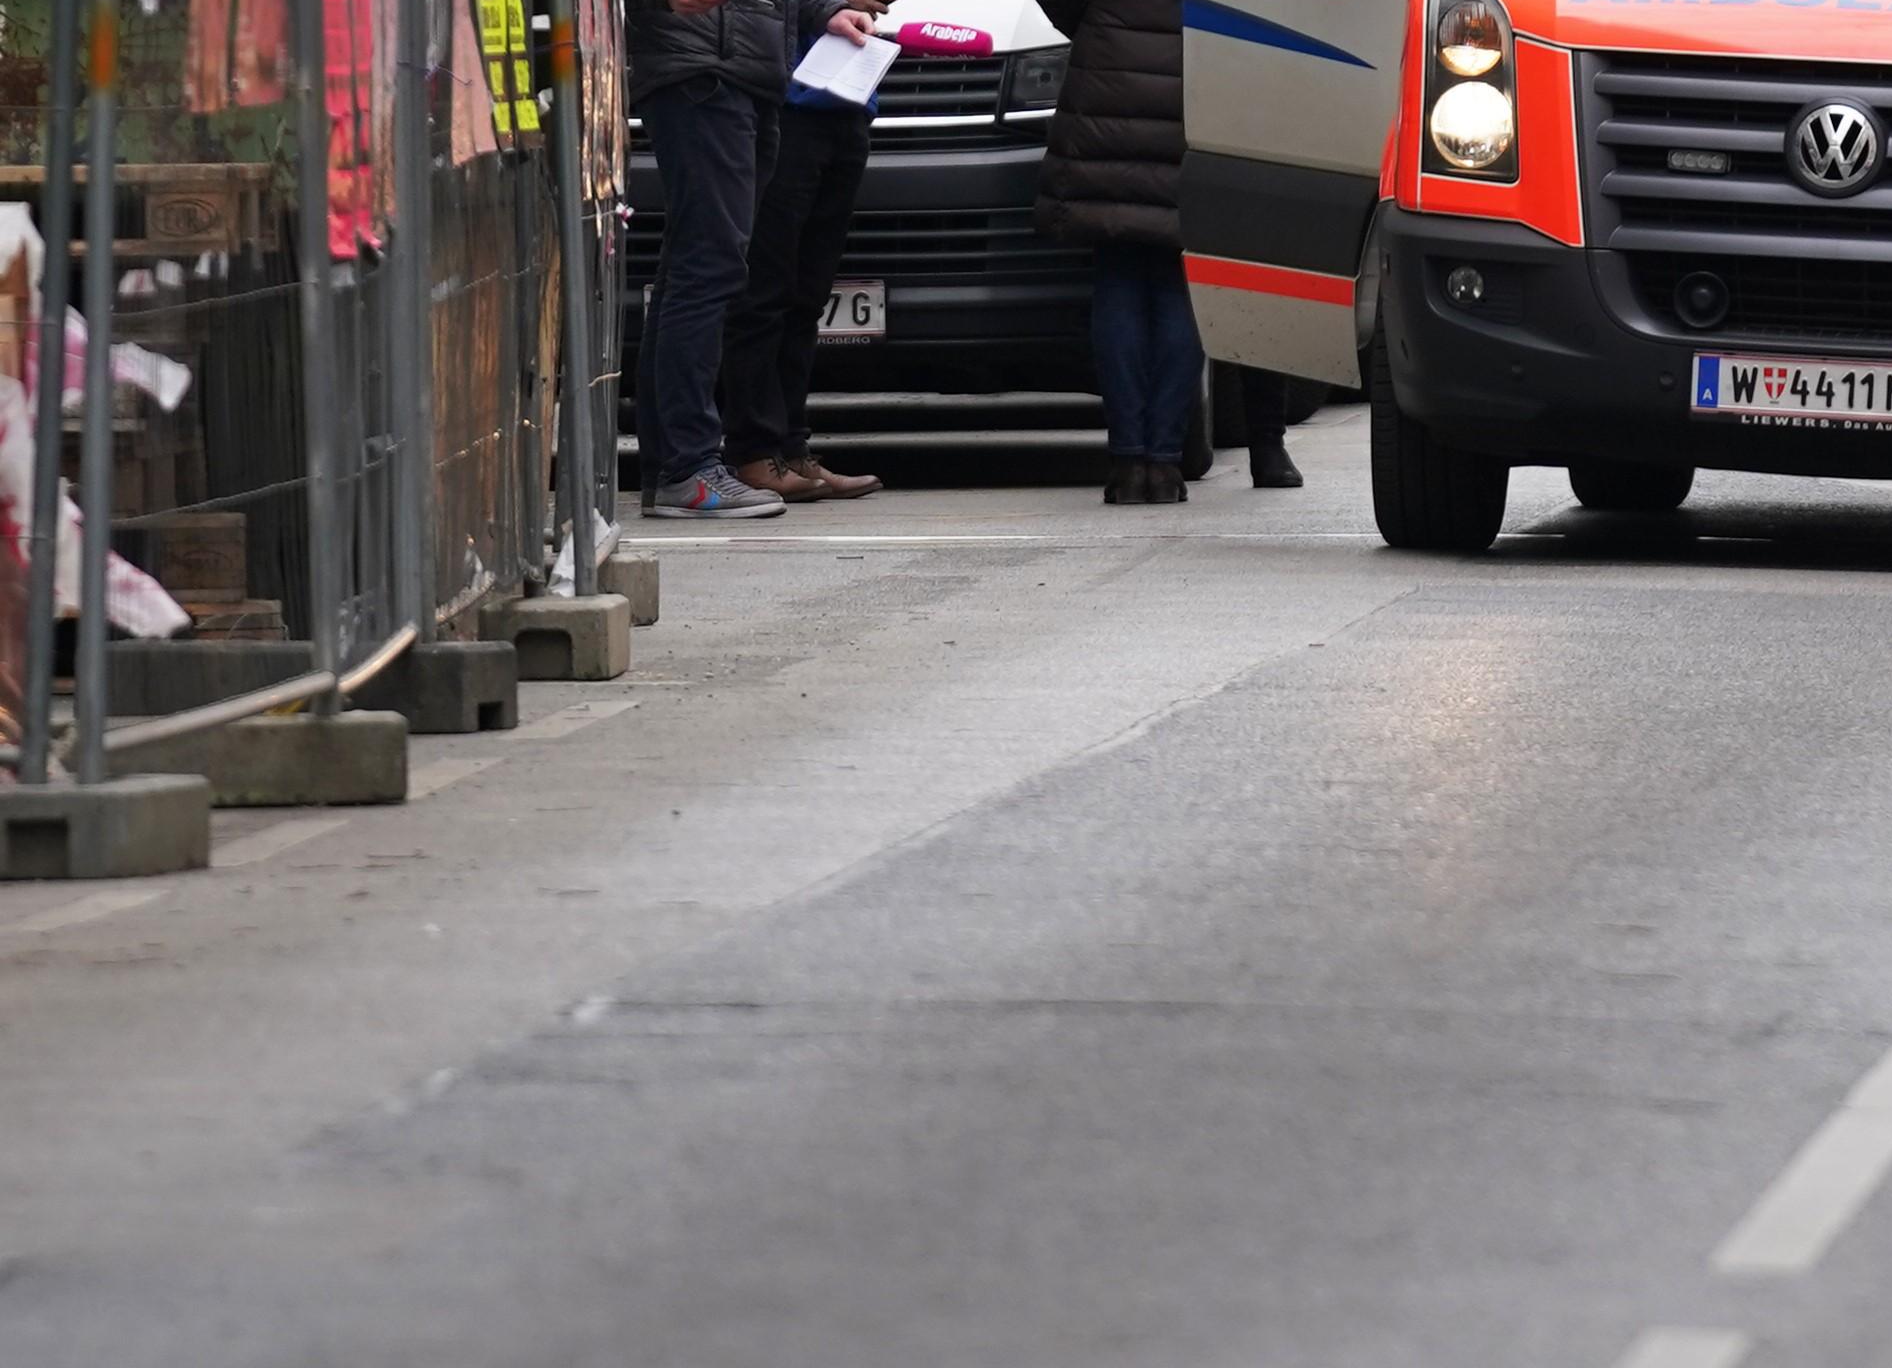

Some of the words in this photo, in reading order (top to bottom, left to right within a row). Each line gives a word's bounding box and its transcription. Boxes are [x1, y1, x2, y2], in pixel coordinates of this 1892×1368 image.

[920, 22, 978, 43] Arabella
[1732, 365, 1759, 404] W
[1702, 388, 1713, 401] A
[1844, 420, 1869, 430] Das
